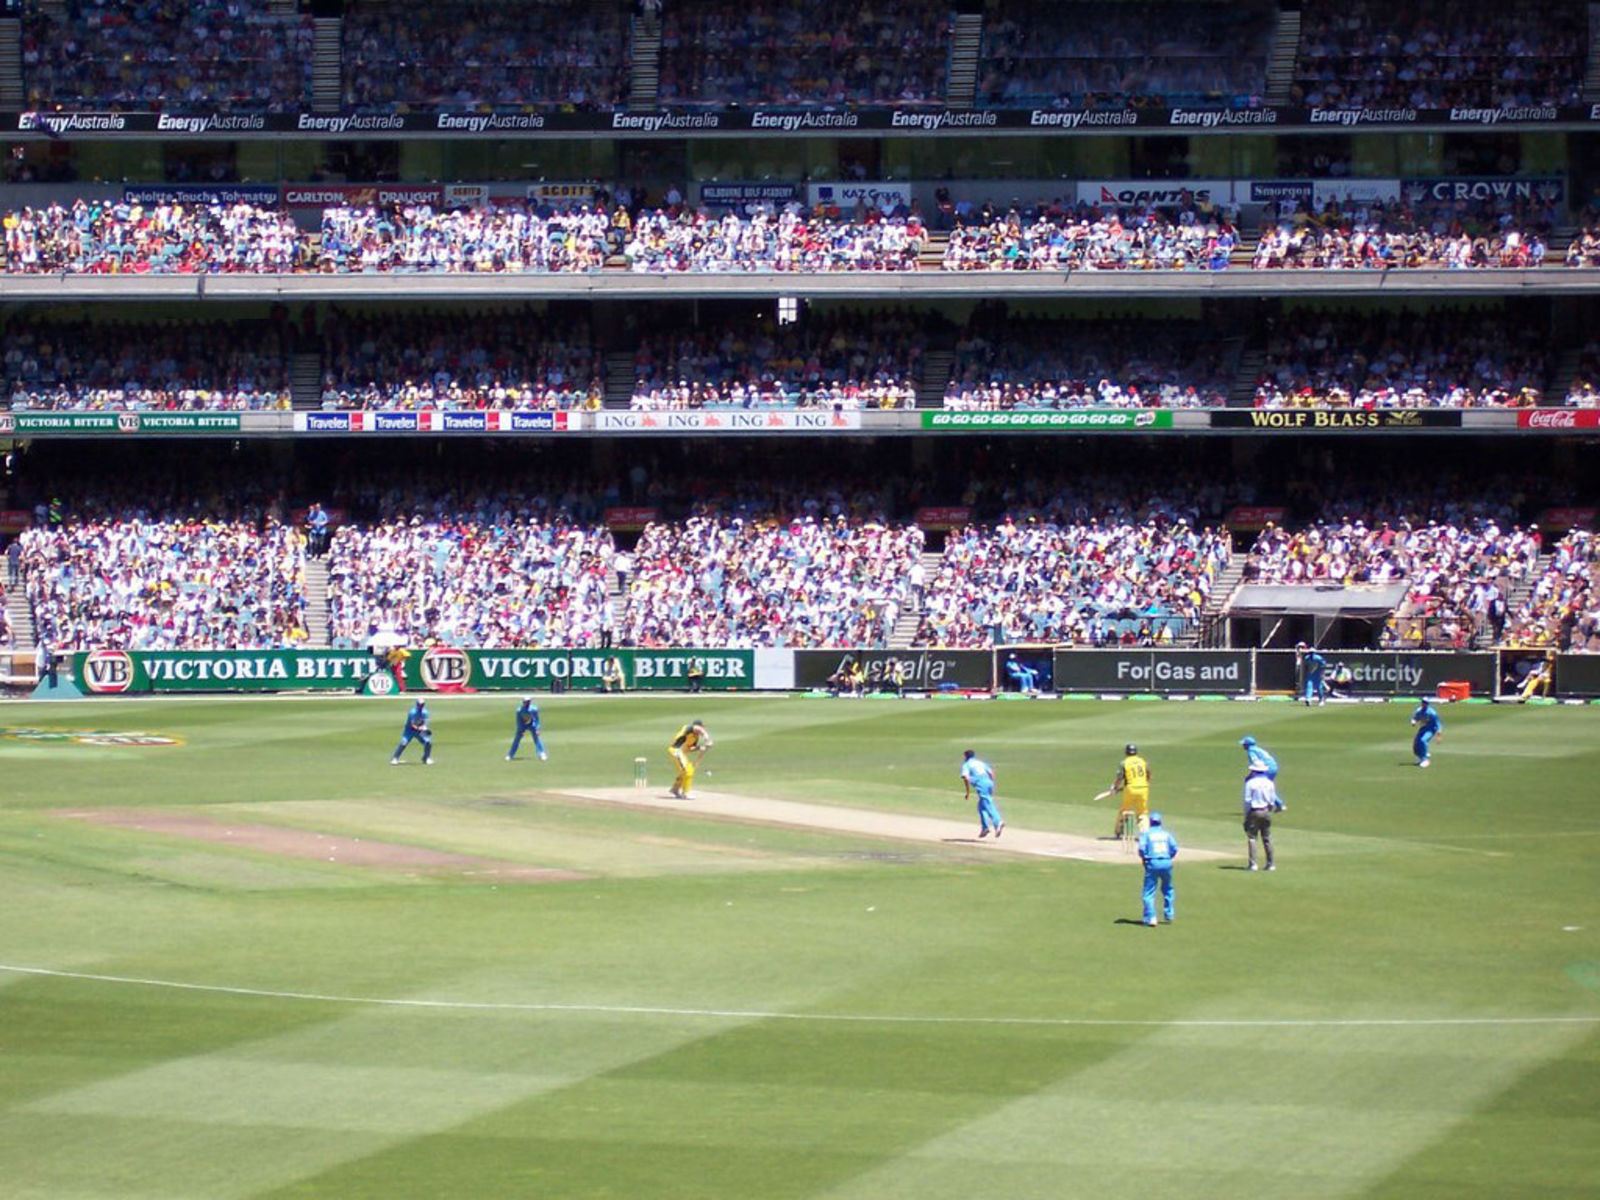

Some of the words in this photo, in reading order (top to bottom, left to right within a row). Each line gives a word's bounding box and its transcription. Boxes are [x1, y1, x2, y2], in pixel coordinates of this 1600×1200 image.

[18, 112, 126, 132] ErgyAustralia
[158, 114, 265, 132] EnergyAustralia
[298, 113, 404, 132] EnergyAustralia
[437, 113, 545, 131] EnergyAustralia
[612, 112, 719, 131] EnergyAustralia
[751, 111, 858, 130] EnergyAustralia
[891, 109, 998, 129] EnergyAustralia
[1030, 109, 1137, 128] EnergyAustralia
[1169, 107, 1277, 126] EnergyAustralia
[1310, 106, 1417, 125] EnergyAustralia
[286, 191, 344, 203] CARLTON
[842, 189, 866, 199] KAZ
[1254, 185, 1312, 199] Smorgon
[1432, 182, 1531, 200] CROWN
[19, 418, 71, 428] VICTORIA
[74, 418, 114, 428] BITTER
[143, 418, 195, 428] VICTORIA
[198, 417, 238, 427] BITTER
[308, 416, 349, 430] Travelex
[376, 416, 417, 430] Travelex
[444, 416, 485, 430] Travelex
[512, 416, 553, 430] Travelex
[604, 414, 636, 428] ING
[667, 414, 699, 428] ING
[731, 414, 763, 428] ING
[795, 414, 827, 428] ING
[1250, 411, 1307, 427] WOLF
[1314, 411, 1379, 427] BLASS
[89, 658, 127, 683] VB
[142, 658, 289, 680] VICTORIA
[296, 658, 408, 678] BITT
[424, 657, 465, 681] VB
[479, 657, 625, 678] VICTORI
[1117, 662, 1150, 680] For
[1155, 662, 1195, 680] Gas
[1201, 662, 1239, 680] and
[1323, 663, 1423, 686] Ectricity
[372, 679, 389, 688] VB
[1130, 765, 1145, 778] 18
